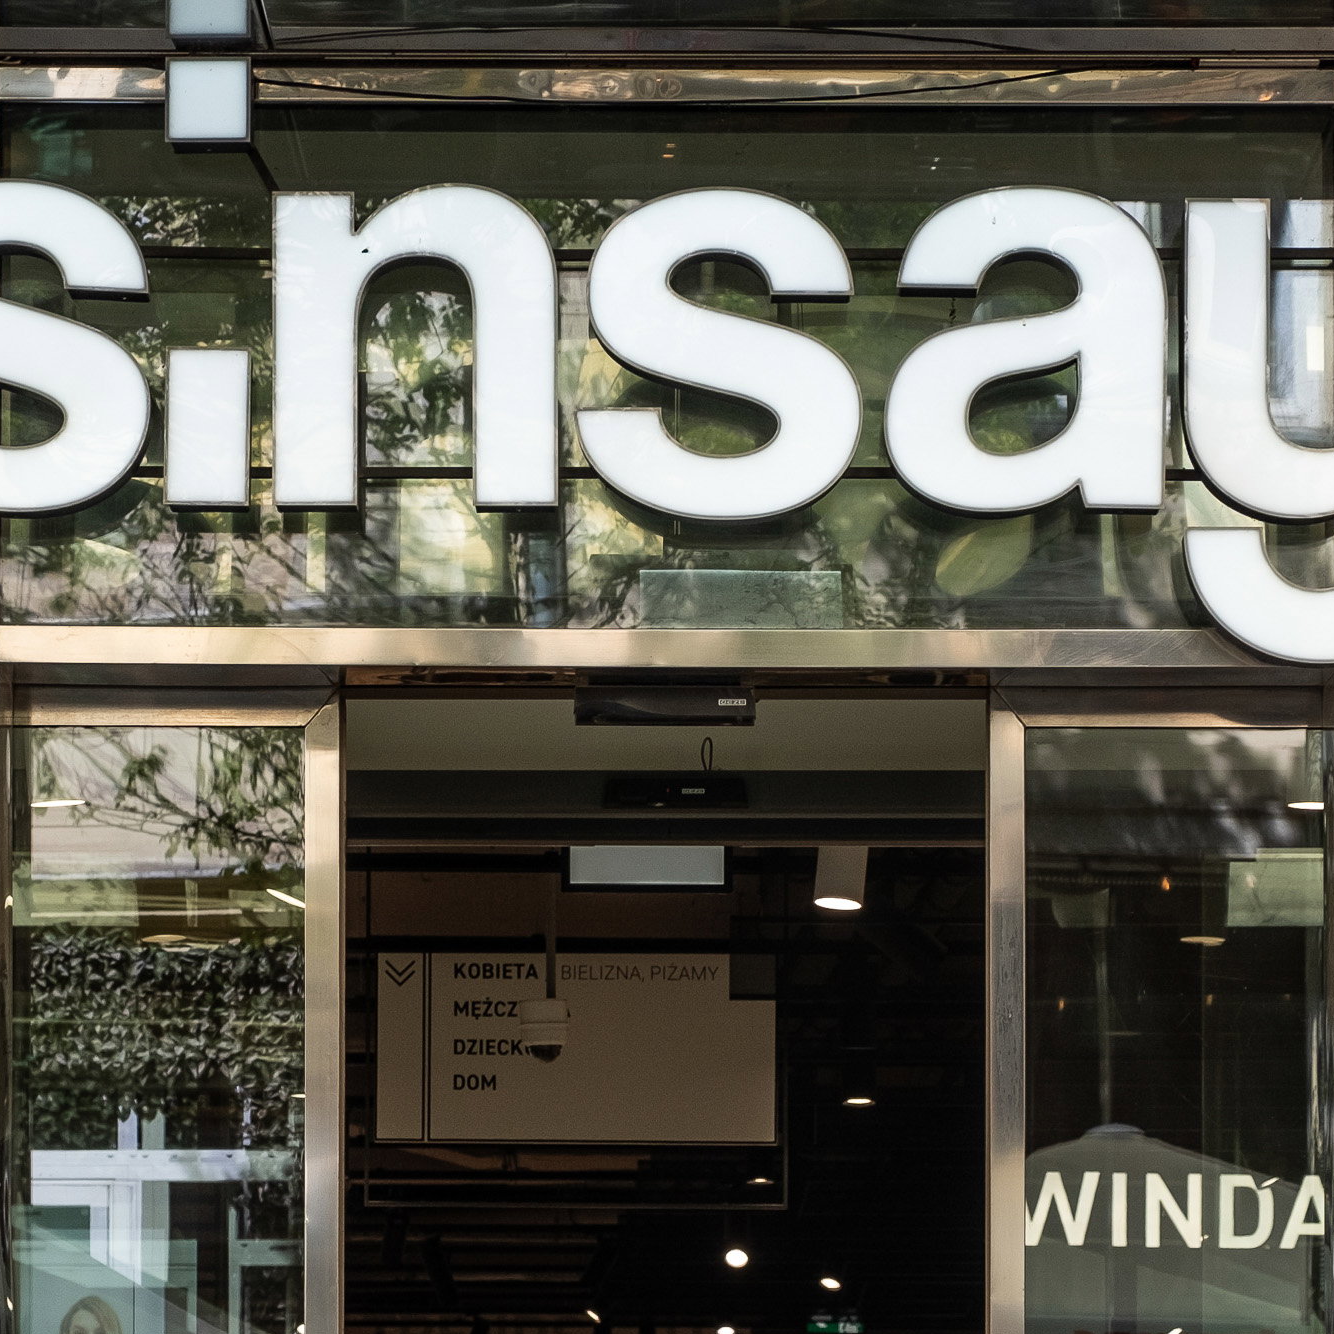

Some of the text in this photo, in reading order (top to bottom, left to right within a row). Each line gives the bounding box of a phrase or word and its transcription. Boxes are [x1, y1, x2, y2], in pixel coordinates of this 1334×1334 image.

[453, 961, 719, 983] KOBIETA BIELIZNA, PIŻAMY
[453, 1039, 529, 1056] DZIECK
[452, 1074, 497, 1091] DOM
[1025, 1171, 1325, 1250] WINDA
